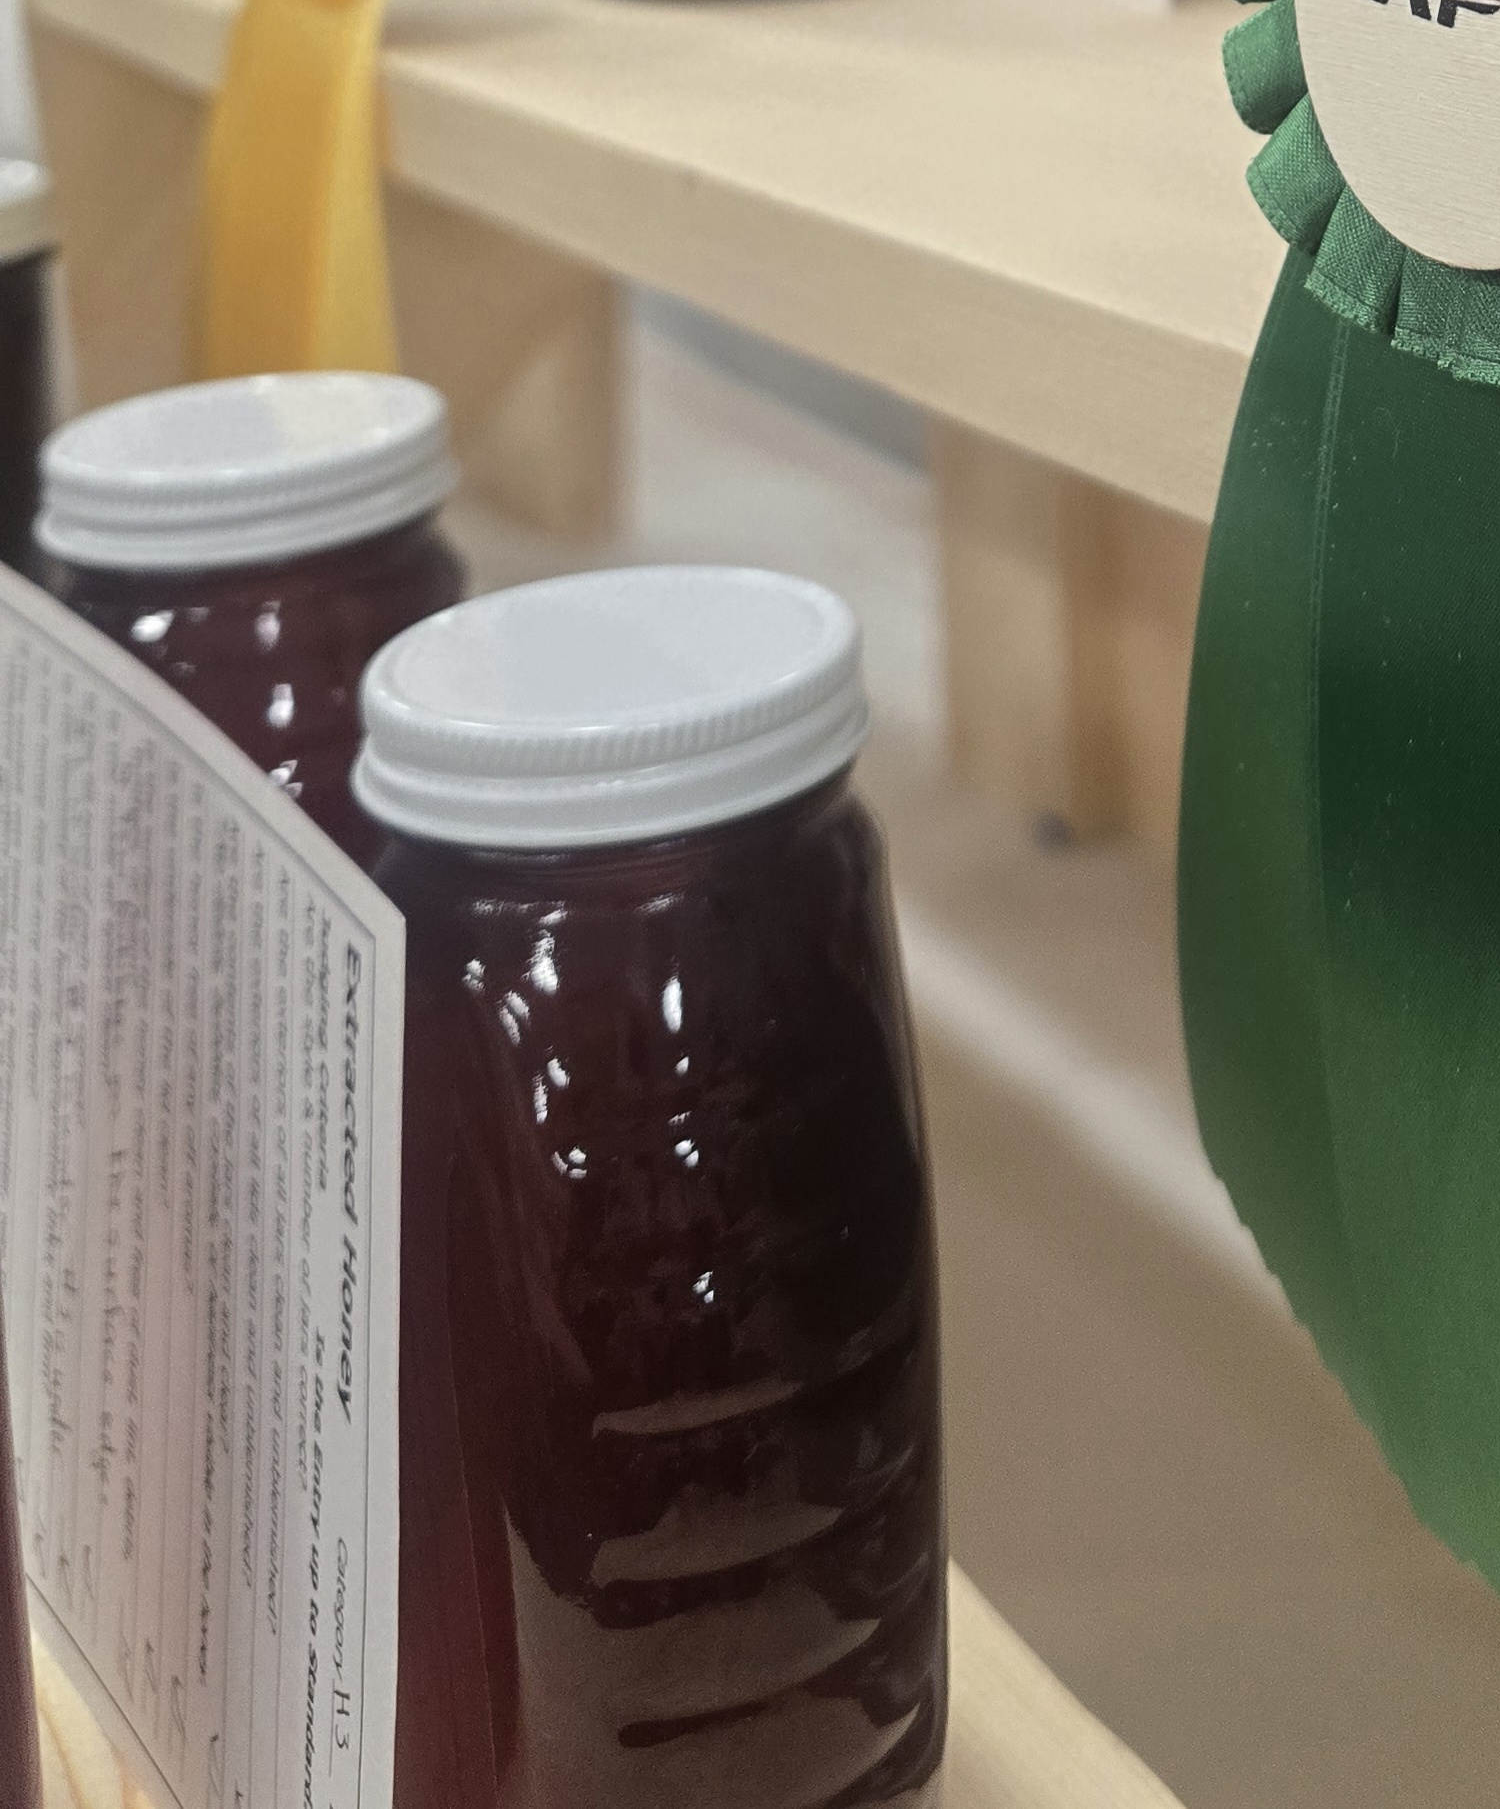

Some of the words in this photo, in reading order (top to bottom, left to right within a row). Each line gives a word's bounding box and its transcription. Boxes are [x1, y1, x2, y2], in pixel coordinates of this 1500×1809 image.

[318, 909, 331, 1051] Judging
[319, 1061, 330, 1190] Criteria
[344, 941, 362, 1226] Extracted
[302, 1129, 314, 1252] number
[274, 1274, 286, 1351] clean
[316, 1327, 326, 1368] Is
[338, 1234, 358, 1425] Honey
[272, 1359, 284, 1421] and
[298, 1365, 309, 1491] correct?
[314, 1374, 325, 1434] the
[242, 1384, 257, 1588] unblemished?
[268, 1427, 282, 1635] unblemished?
[310, 1440, 324, 1540] Entry
[309, 1543, 322, 1591] up
[309, 1598, 320, 1635] to
[333, 1537, 349, 1682] Category
[303, 1642, 318, 1809] Standard
